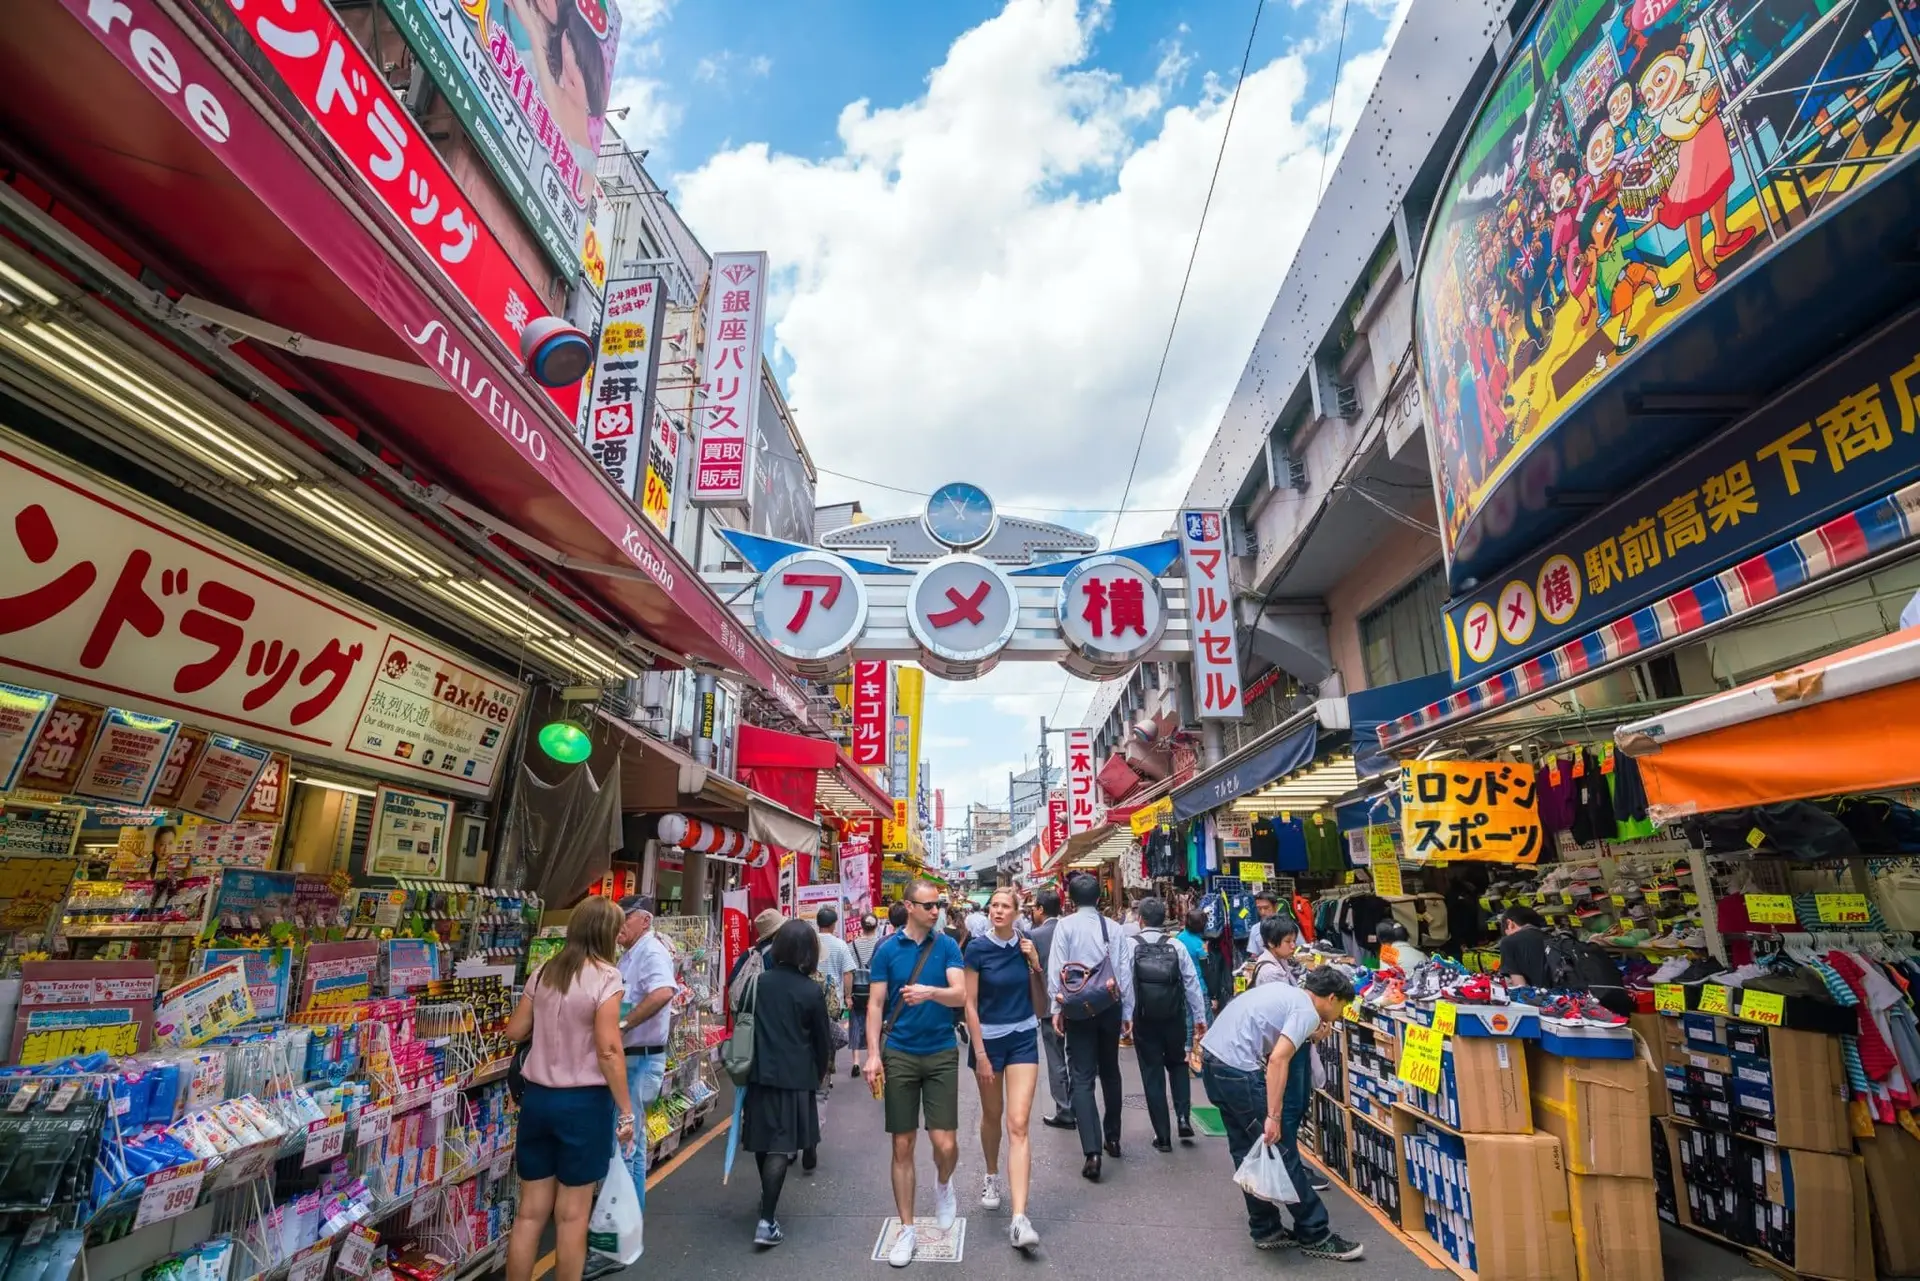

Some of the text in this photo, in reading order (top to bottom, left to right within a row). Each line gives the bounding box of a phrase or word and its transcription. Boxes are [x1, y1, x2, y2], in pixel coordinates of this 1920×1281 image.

[463, 36, 530, 154] いちごナビ
[490, 22, 587, 204] お仕事探し
[230, 0, 478, 264] ンドラッグ
[608, 282, 653, 305] 24時間
[708, 290, 751, 430] 銀座パリス
[404, 321, 547, 462] SHISEIDO
[700, 468, 741, 488] 販売
[703, 443, 742, 461] 買取
[621, 524, 674, 592] Kanebo
[0, 504, 363, 727] ンドラッグ
[782, 572, 1148, 640] アメ横
[1190, 548, 1237, 711] マルセル
[1469, 565, 1575, 652] アメ横
[433, 671, 509, 724] Tax-free
[28, 710, 85, 779] 欢迎
[366, 735, 383, 748] VISA
[1214, 774, 1240, 799] マルセル
[1416, 766, 1537, 810] ロンドン
[1415, 813, 1538, 858] スポーツ
[51, 982, 90, 991] Tax-free
[119, 980, 152, 989] Tax-free
[321, 1134, 340, 1154] 648
[164, 1187, 195, 1212] 399
